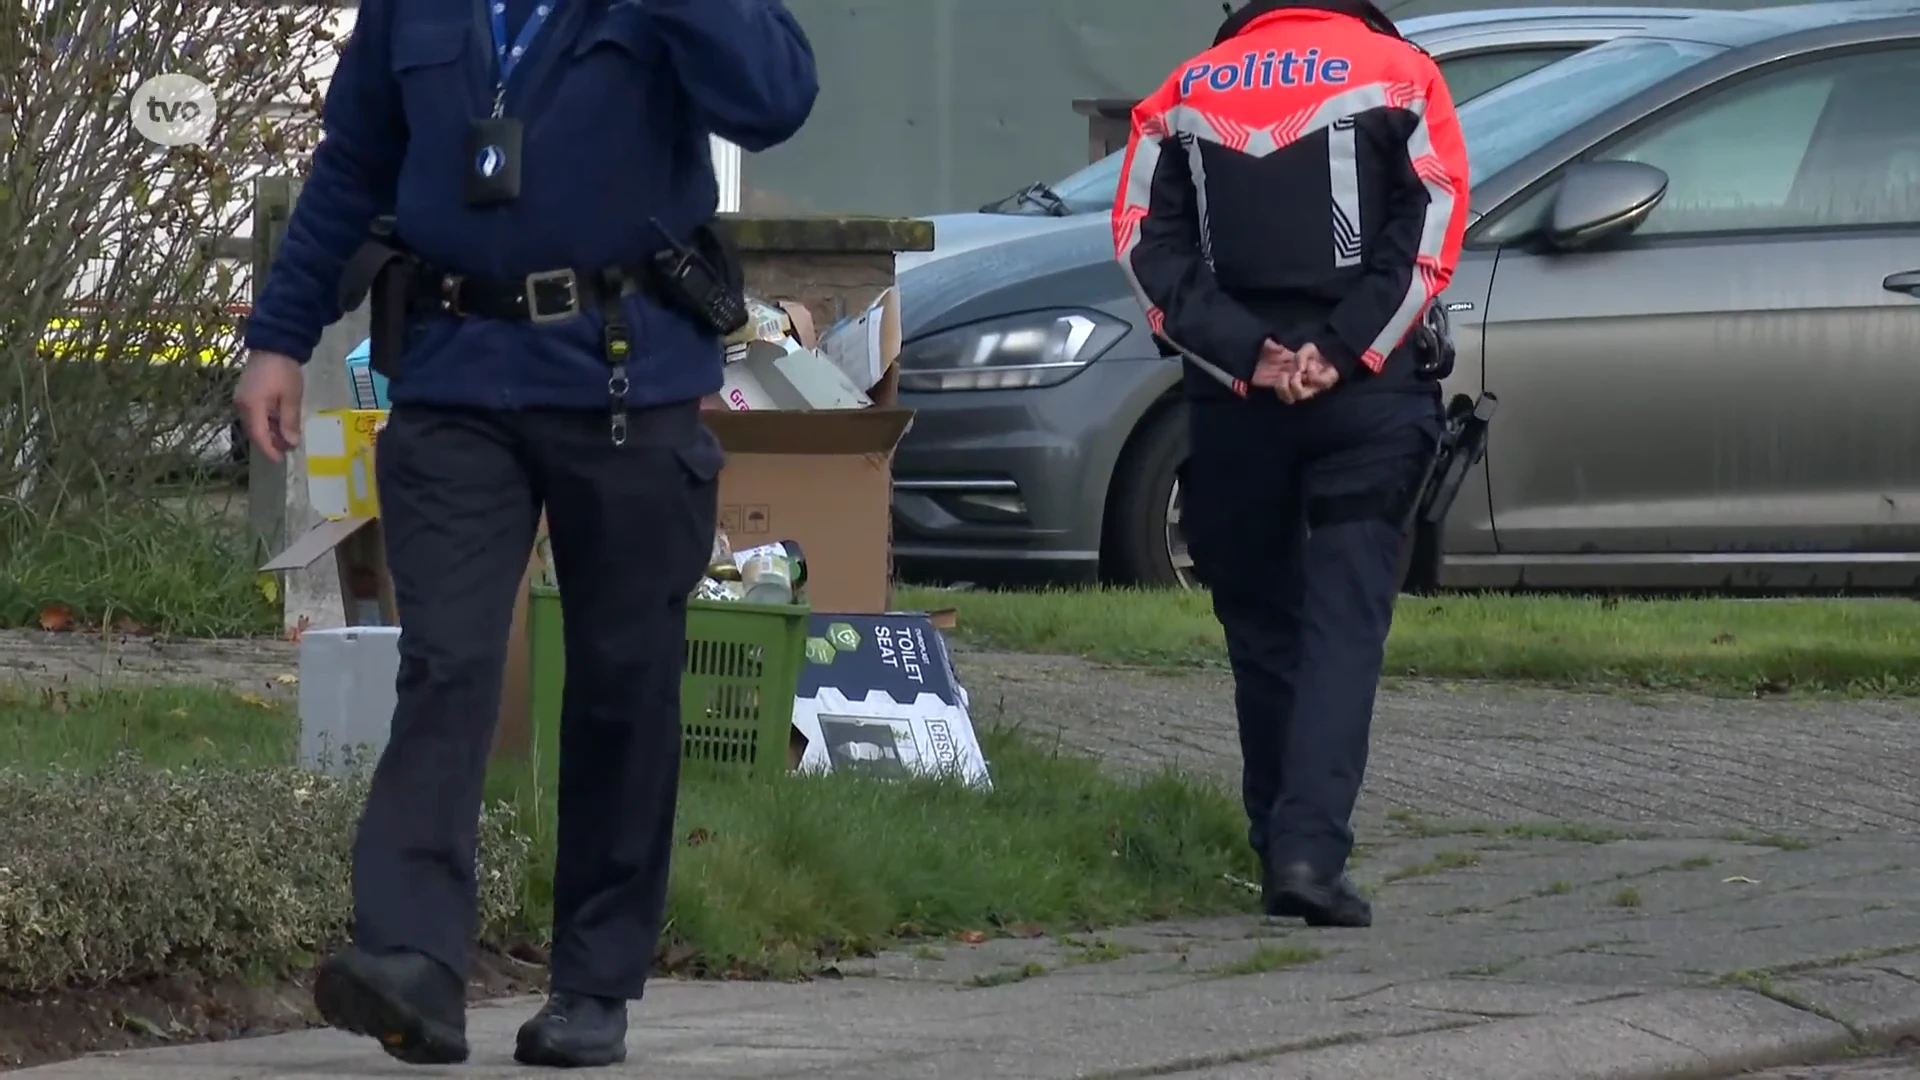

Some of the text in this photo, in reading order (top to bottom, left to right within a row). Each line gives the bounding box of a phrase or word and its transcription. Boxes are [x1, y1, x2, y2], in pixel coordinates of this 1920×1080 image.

[1181, 49, 1350, 97] Politie
[875, 626, 898, 667] SEAT
[896, 627, 923, 684] TOILET
